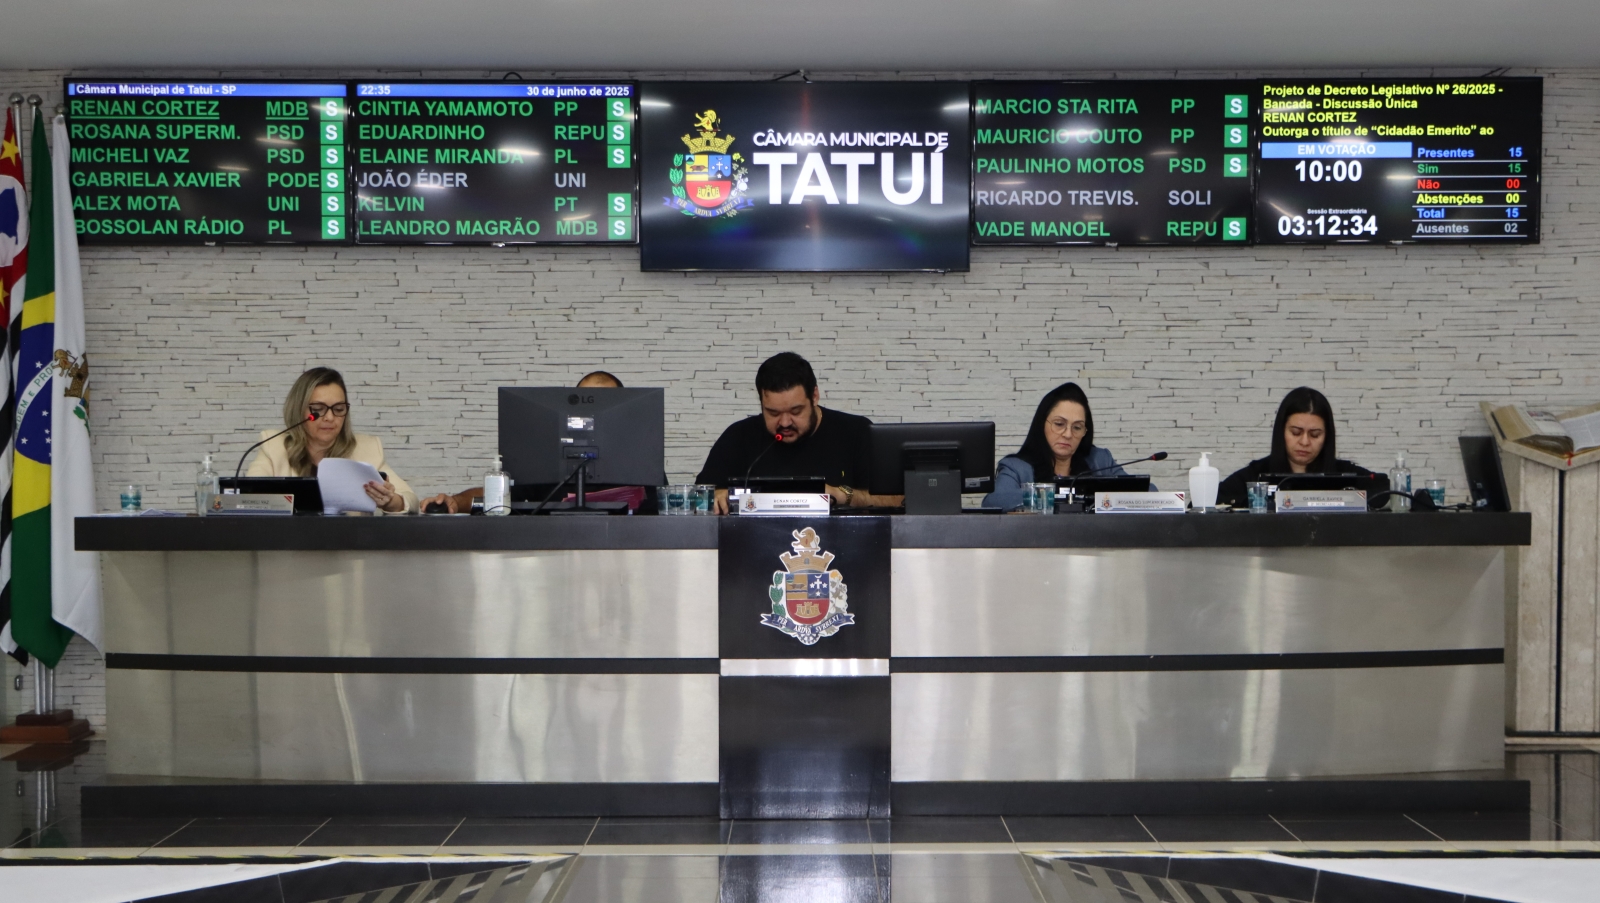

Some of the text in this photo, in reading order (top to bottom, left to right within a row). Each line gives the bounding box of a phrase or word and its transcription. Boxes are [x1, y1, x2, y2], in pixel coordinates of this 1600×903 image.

[76, 85, 116, 94] Câmara
[119, 85, 169, 96] Municipal
[172, 86, 184, 94] de
[222, 86, 236, 94] SP
[361, 86, 390, 95] 22:35
[527, 87, 629, 97] 30 de junho de 2025
[1264, 86, 1304, 98] Projeto
[1307, 86, 1320, 95] de
[1324, 86, 1368, 95] Decreto
[1372, 85, 1432, 97] Legislativo
[1452, 84, 1495, 94] 26/2025
[71, 101, 338, 116] RENAN CORTEZ MDB S
[359, 102, 624, 116] CINTIA YAMAMOTO PP S
[978, 99, 1242, 114] MARCIO STA RITA PP S
[1263, 100, 1312, 109] Bancada
[1323, 99, 1382, 109] Discussão
[1386, 96, 1417, 108] Única
[1263, 113, 1356, 122] RENAN CORTEZ
[71, 125, 338, 140] ROSANA SUPERM. PSD S
[360, 125, 624, 140] EDUARDINHO REPU S
[753, 129, 948, 146] CÂMARA MUNICIPAL DE
[977, 129, 1242, 144] MAURICIO COUTO PP S
[1263, 126, 1308, 138] Outorga
[1322, 126, 1350, 136] título
[1354, 126, 1368, 136] de
[72, 149, 338, 164] MICHELI VAZ PSD S
[360, 149, 624, 164] ELAINE MIRANDA PL S
[1298, 142, 1376, 157] EM VOTAÇÃO
[1418, 148, 1522, 158] Presentes 15
[977, 158, 1241, 173] PAULINHO MOTOS PSD S
[1295, 160, 1362, 181] 10:00
[1418, 164, 1521, 173] Sim 15
[72, 172, 338, 188] GABRIELA XAVIER PODE S
[359, 169, 586, 187] JOÃO ÉDER UNI
[753, 145, 948, 205] TATUÍ
[1417, 179, 1520, 189] Não 00
[74, 196, 338, 211] ALEX MOTA UNI S
[360, 197, 625, 212] KELVIN PT S
[977, 190, 1211, 205] RICARDO TREVIS. SOLI
[1417, 194, 1519, 205] Abstenções 00
[1417, 208, 1518, 218] Total 15
[76, 216, 339, 235] BOSSOLAN RÁDIO PL S
[360, 217, 626, 235] LEANDRO MAGRÃO MDB S
[976, 221, 1240, 236] VADE MANOEL REPU S
[1278, 215, 1377, 235] 03:12:34
[1416, 223, 1517, 233] Ausentes 02
[582, 396, 594, 404] LG
